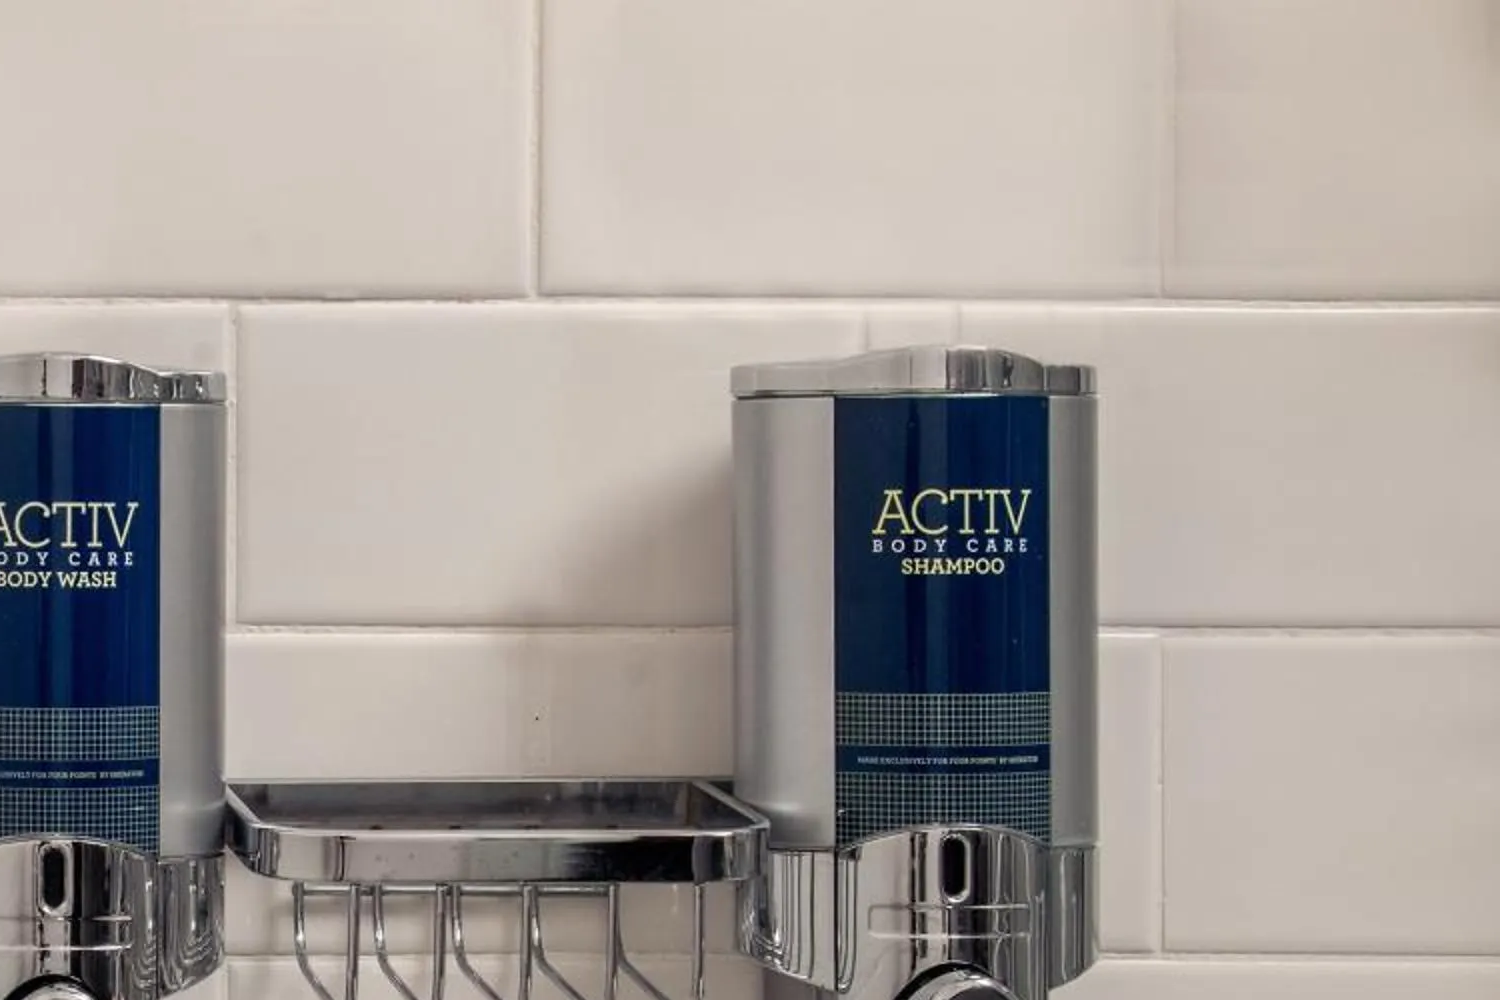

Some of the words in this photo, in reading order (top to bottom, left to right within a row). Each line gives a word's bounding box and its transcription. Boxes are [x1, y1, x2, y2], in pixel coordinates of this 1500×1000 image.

[871, 489, 1032, 535] ACTIV
[872, 538, 947, 553] BODY
[966, 538, 1028, 553] CARE
[68, 551, 133, 566] CARE
[901, 557, 1005, 575] SHAMPOO
[57, 570, 117, 588] WASH
